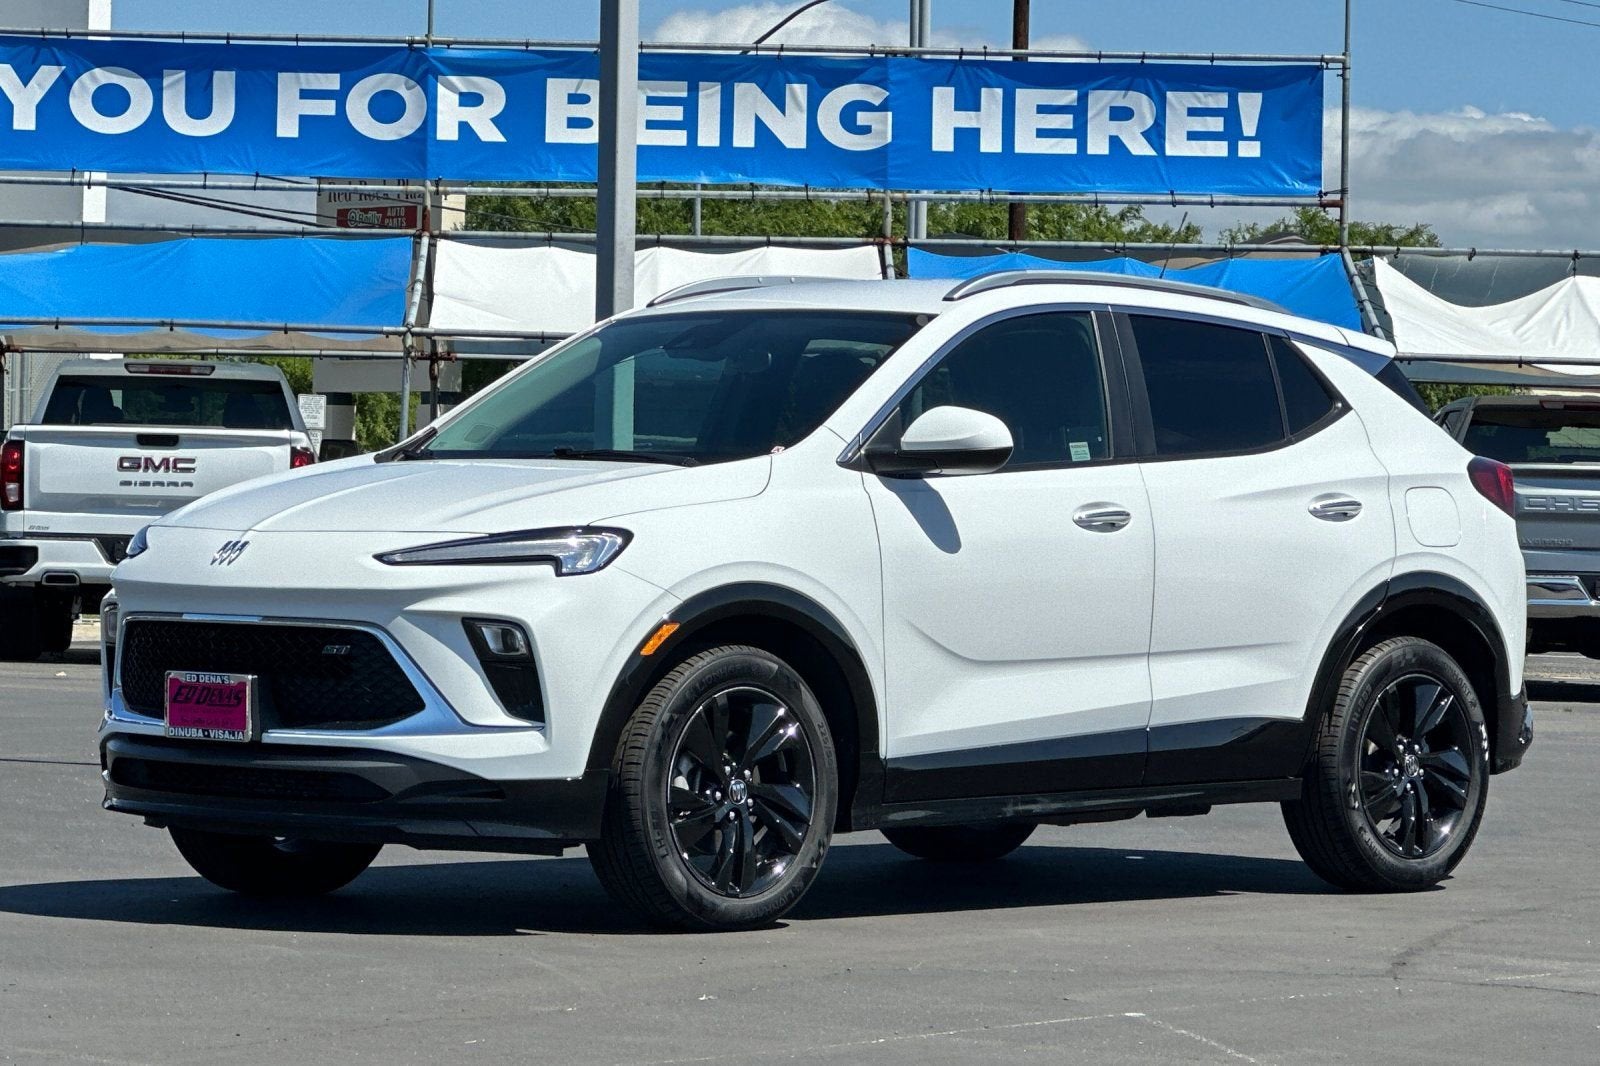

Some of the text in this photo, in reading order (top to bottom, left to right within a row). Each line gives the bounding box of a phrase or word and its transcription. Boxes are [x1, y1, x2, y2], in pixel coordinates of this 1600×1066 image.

[0, 63, 1263, 159] YOU FOR BEING HERE!
[387, 207, 405, 217] AUTO
[384, 218, 407, 227] PARTS
[117, 456, 196, 473] GMC
[186, 674, 230, 684] ED DENA'S
[169, 727, 244, 740] DINUBA VISALIA
